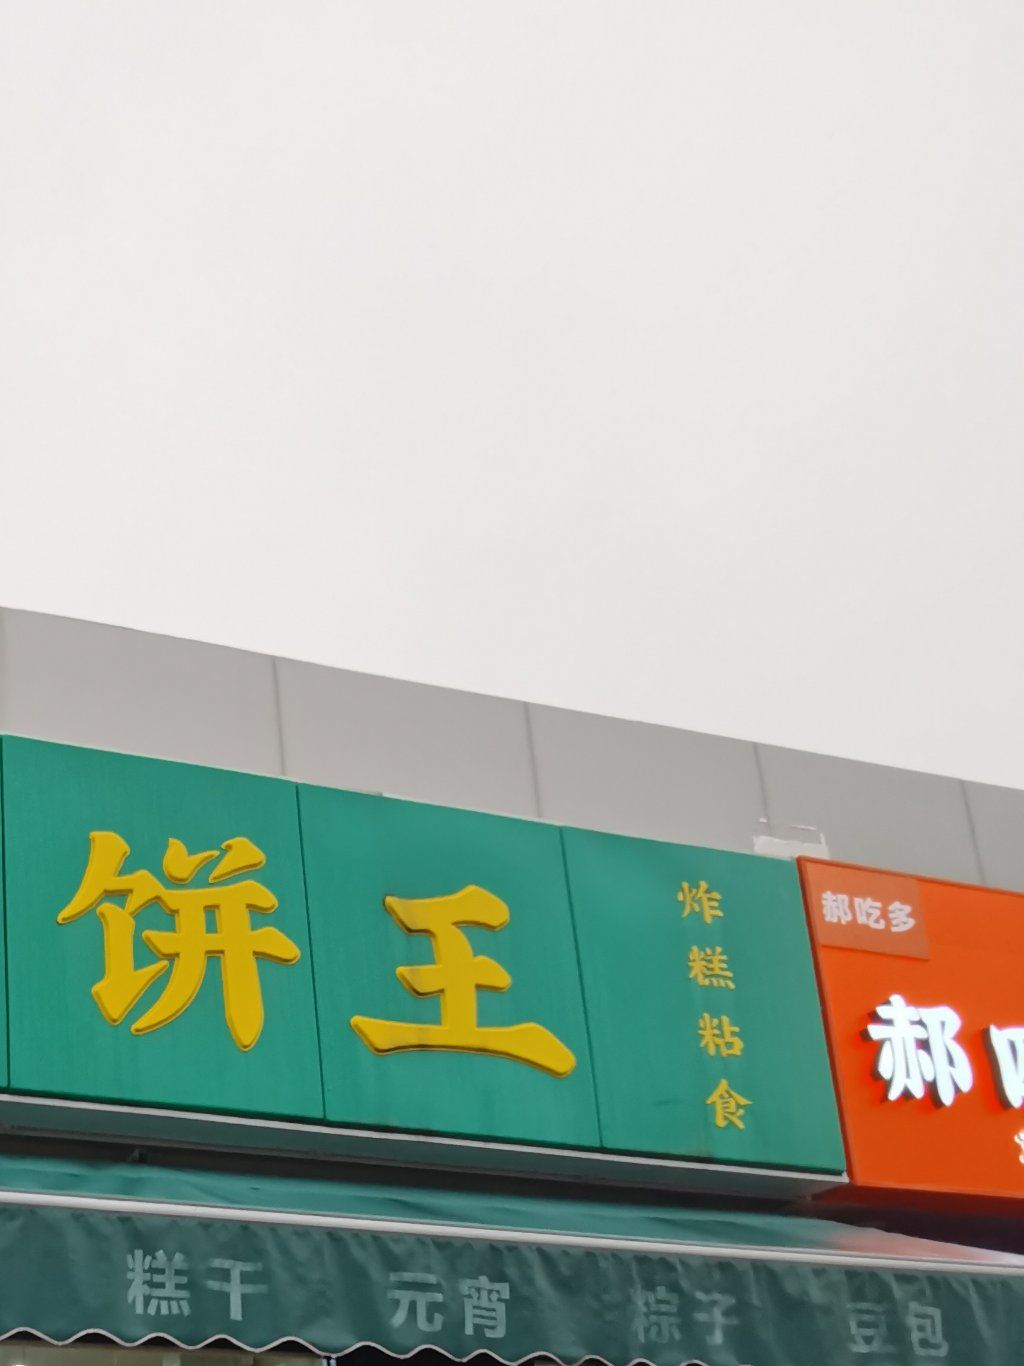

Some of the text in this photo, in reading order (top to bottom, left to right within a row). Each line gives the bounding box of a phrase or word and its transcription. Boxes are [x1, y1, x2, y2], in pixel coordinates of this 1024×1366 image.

[820, 890, 918, 933] 郝吃多
[678, 880, 753, 1132] 炸糕粘食
[386, 1271, 512, 1340] 元宵
[848, 1304, 952, 1358] 豆包
